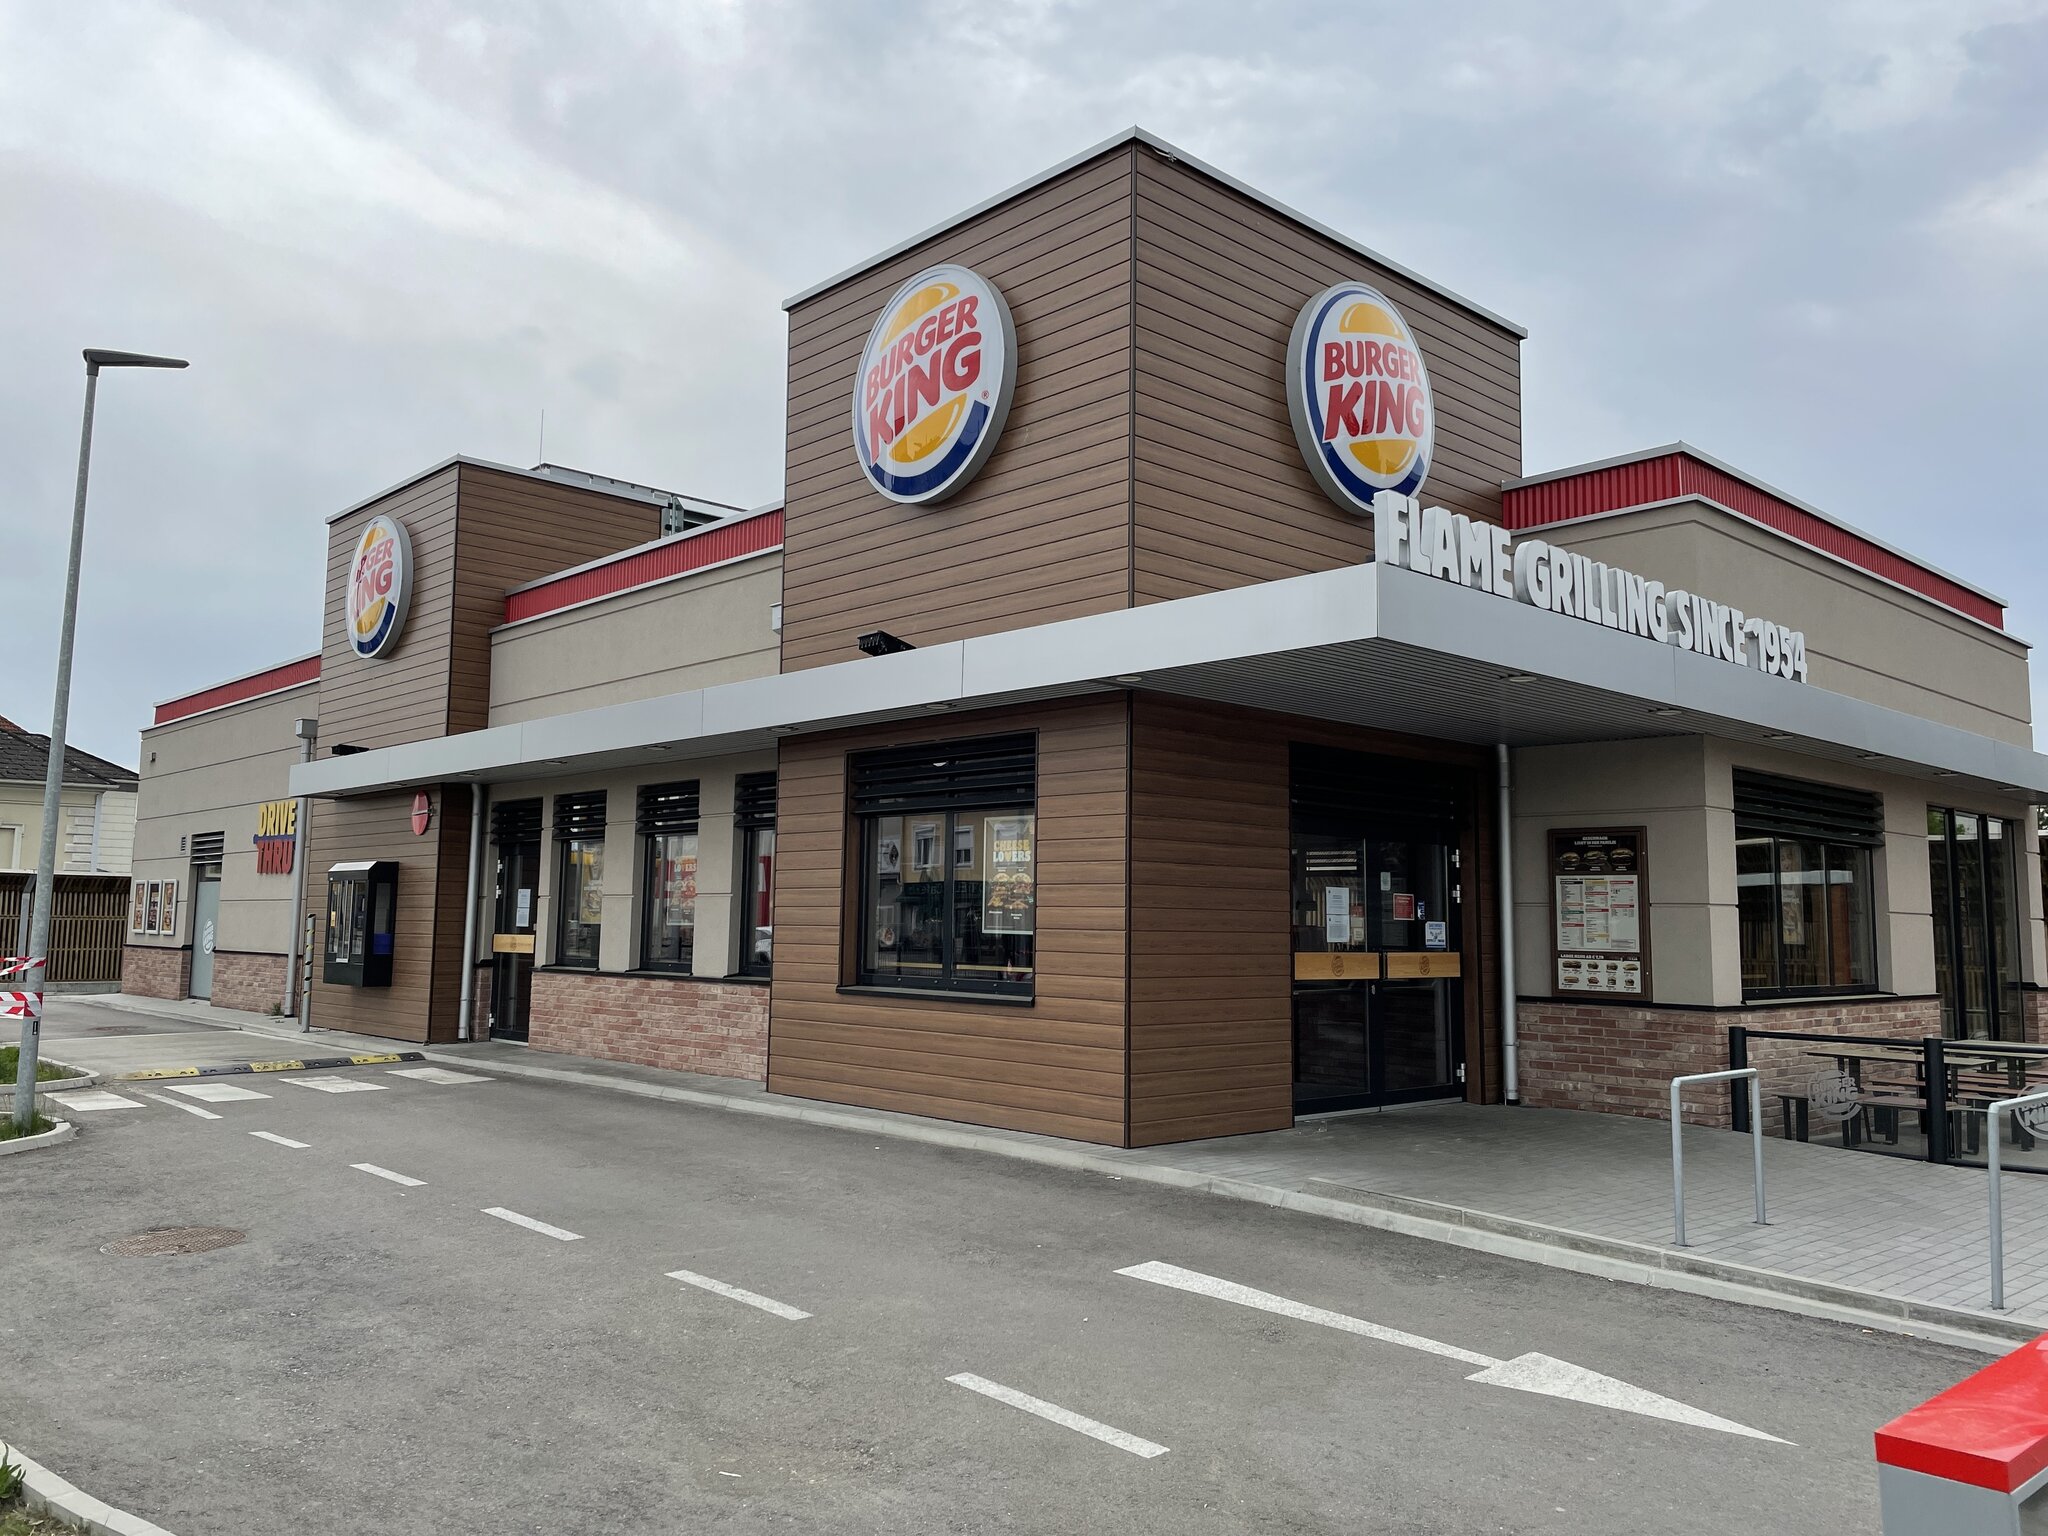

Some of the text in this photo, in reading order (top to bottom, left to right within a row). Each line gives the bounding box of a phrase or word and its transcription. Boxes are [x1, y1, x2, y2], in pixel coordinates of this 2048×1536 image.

[866, 295, 979, 412] BURGER
[1323, 340, 1422, 386] BURGER
[869, 331, 982, 466] KING
[1323, 380, 1425, 442] KING
[1373, 489, 1808, 684] FLAME GRILLING SINCE 1954
[258, 801, 296, 836] DRIVE
[256, 840, 295, 874] THRU
[993, 840, 1030, 851] CHEESE
[1813, 1086, 1858, 1109] KING
[2024, 1106, 2048, 1127] KI
